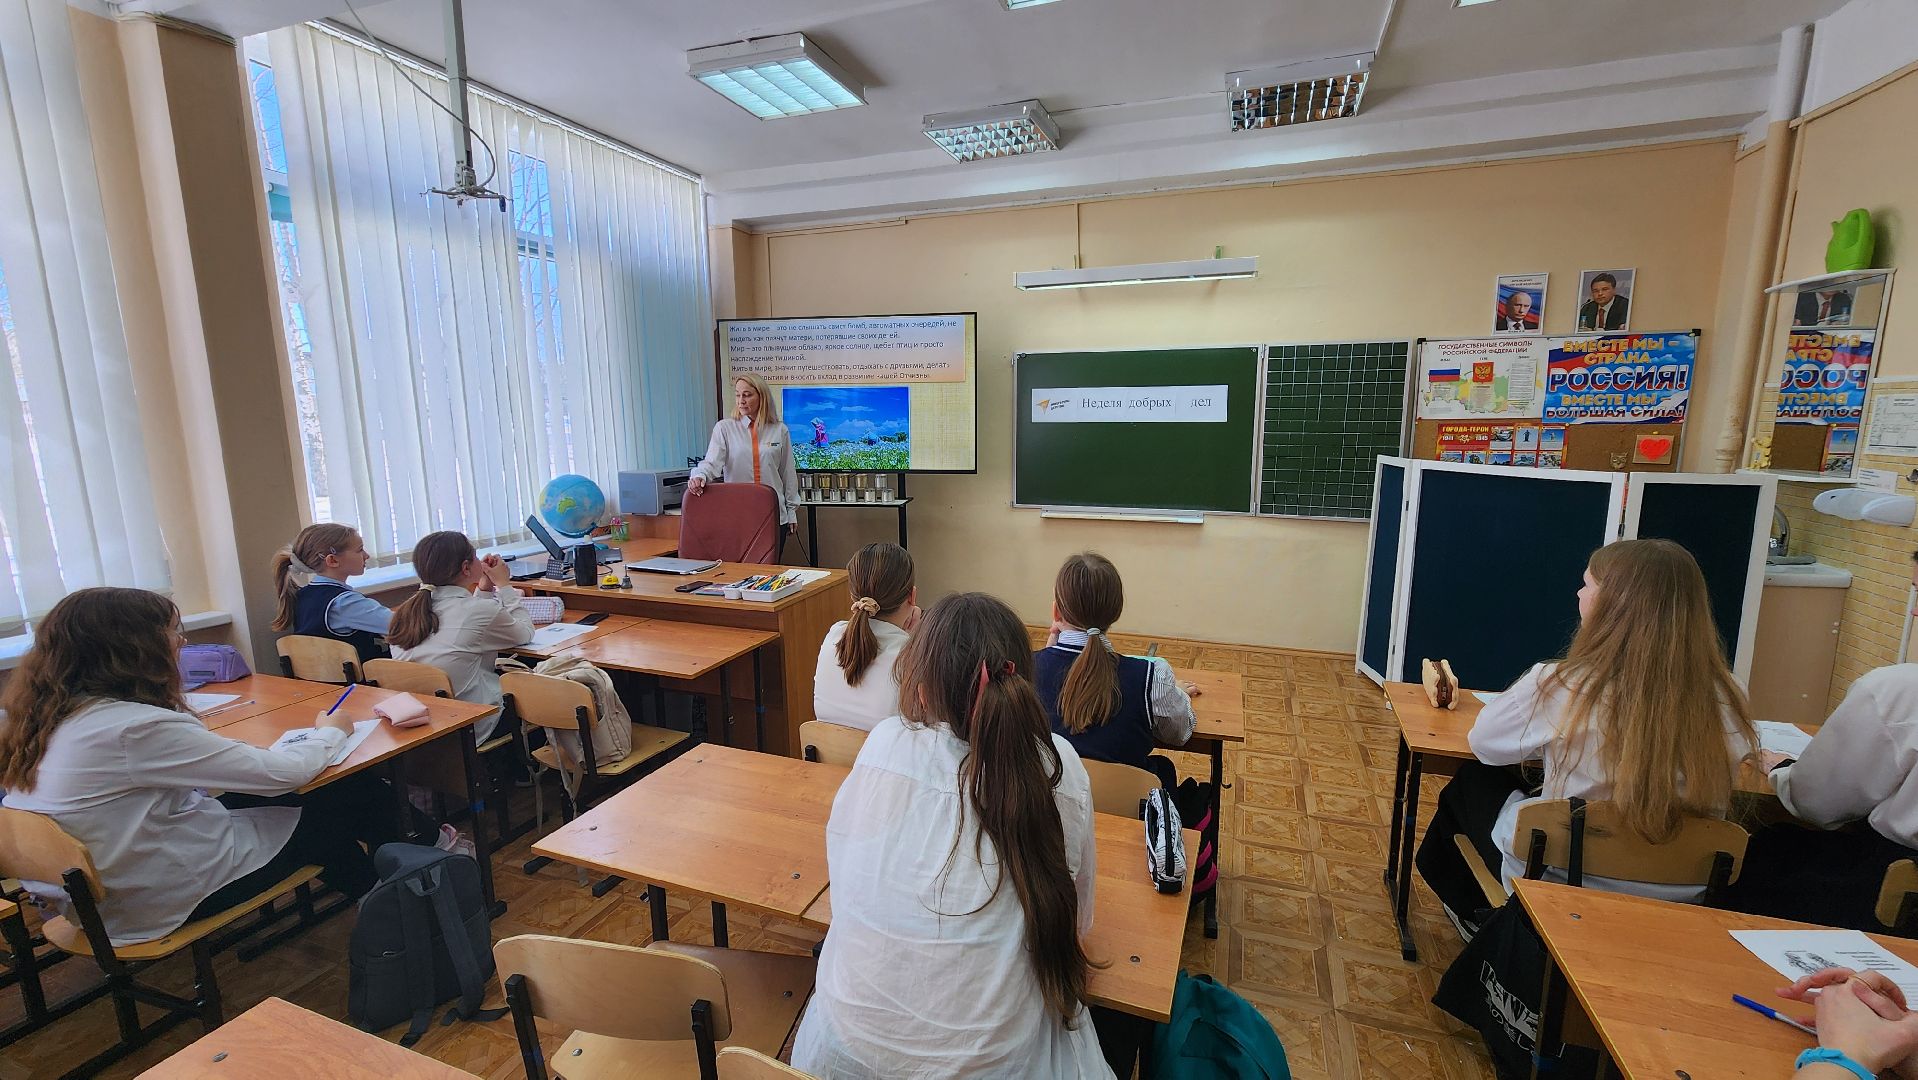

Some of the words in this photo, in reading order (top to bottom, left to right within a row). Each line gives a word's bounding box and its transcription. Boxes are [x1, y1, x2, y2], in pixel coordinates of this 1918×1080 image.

[1438, 342, 1498, 350] ГОСУДАРСТВЕННЫЕ
[1442, 348, 1487, 356] РОССИЙСКОЙ
[1563, 339, 1630, 353] ВМЕСТЕ
[1632, 338, 1664, 351] МЫ
[1584, 352, 1651, 365] СТРАНА
[1549, 364, 1689, 393] РОССИЯ!
[1082, 398, 1122, 409] Неделя
[1128, 397, 1172, 410] добрых
[1191, 398, 1211, 408] дел
[1561, 394, 1624, 407] ВМЕСТЕ
[1626, 393, 1658, 405] МЫ
[1546, 406, 1627, 418] БОЛЬШАЯ
[1631, 405, 1685, 418] СИЛА!
